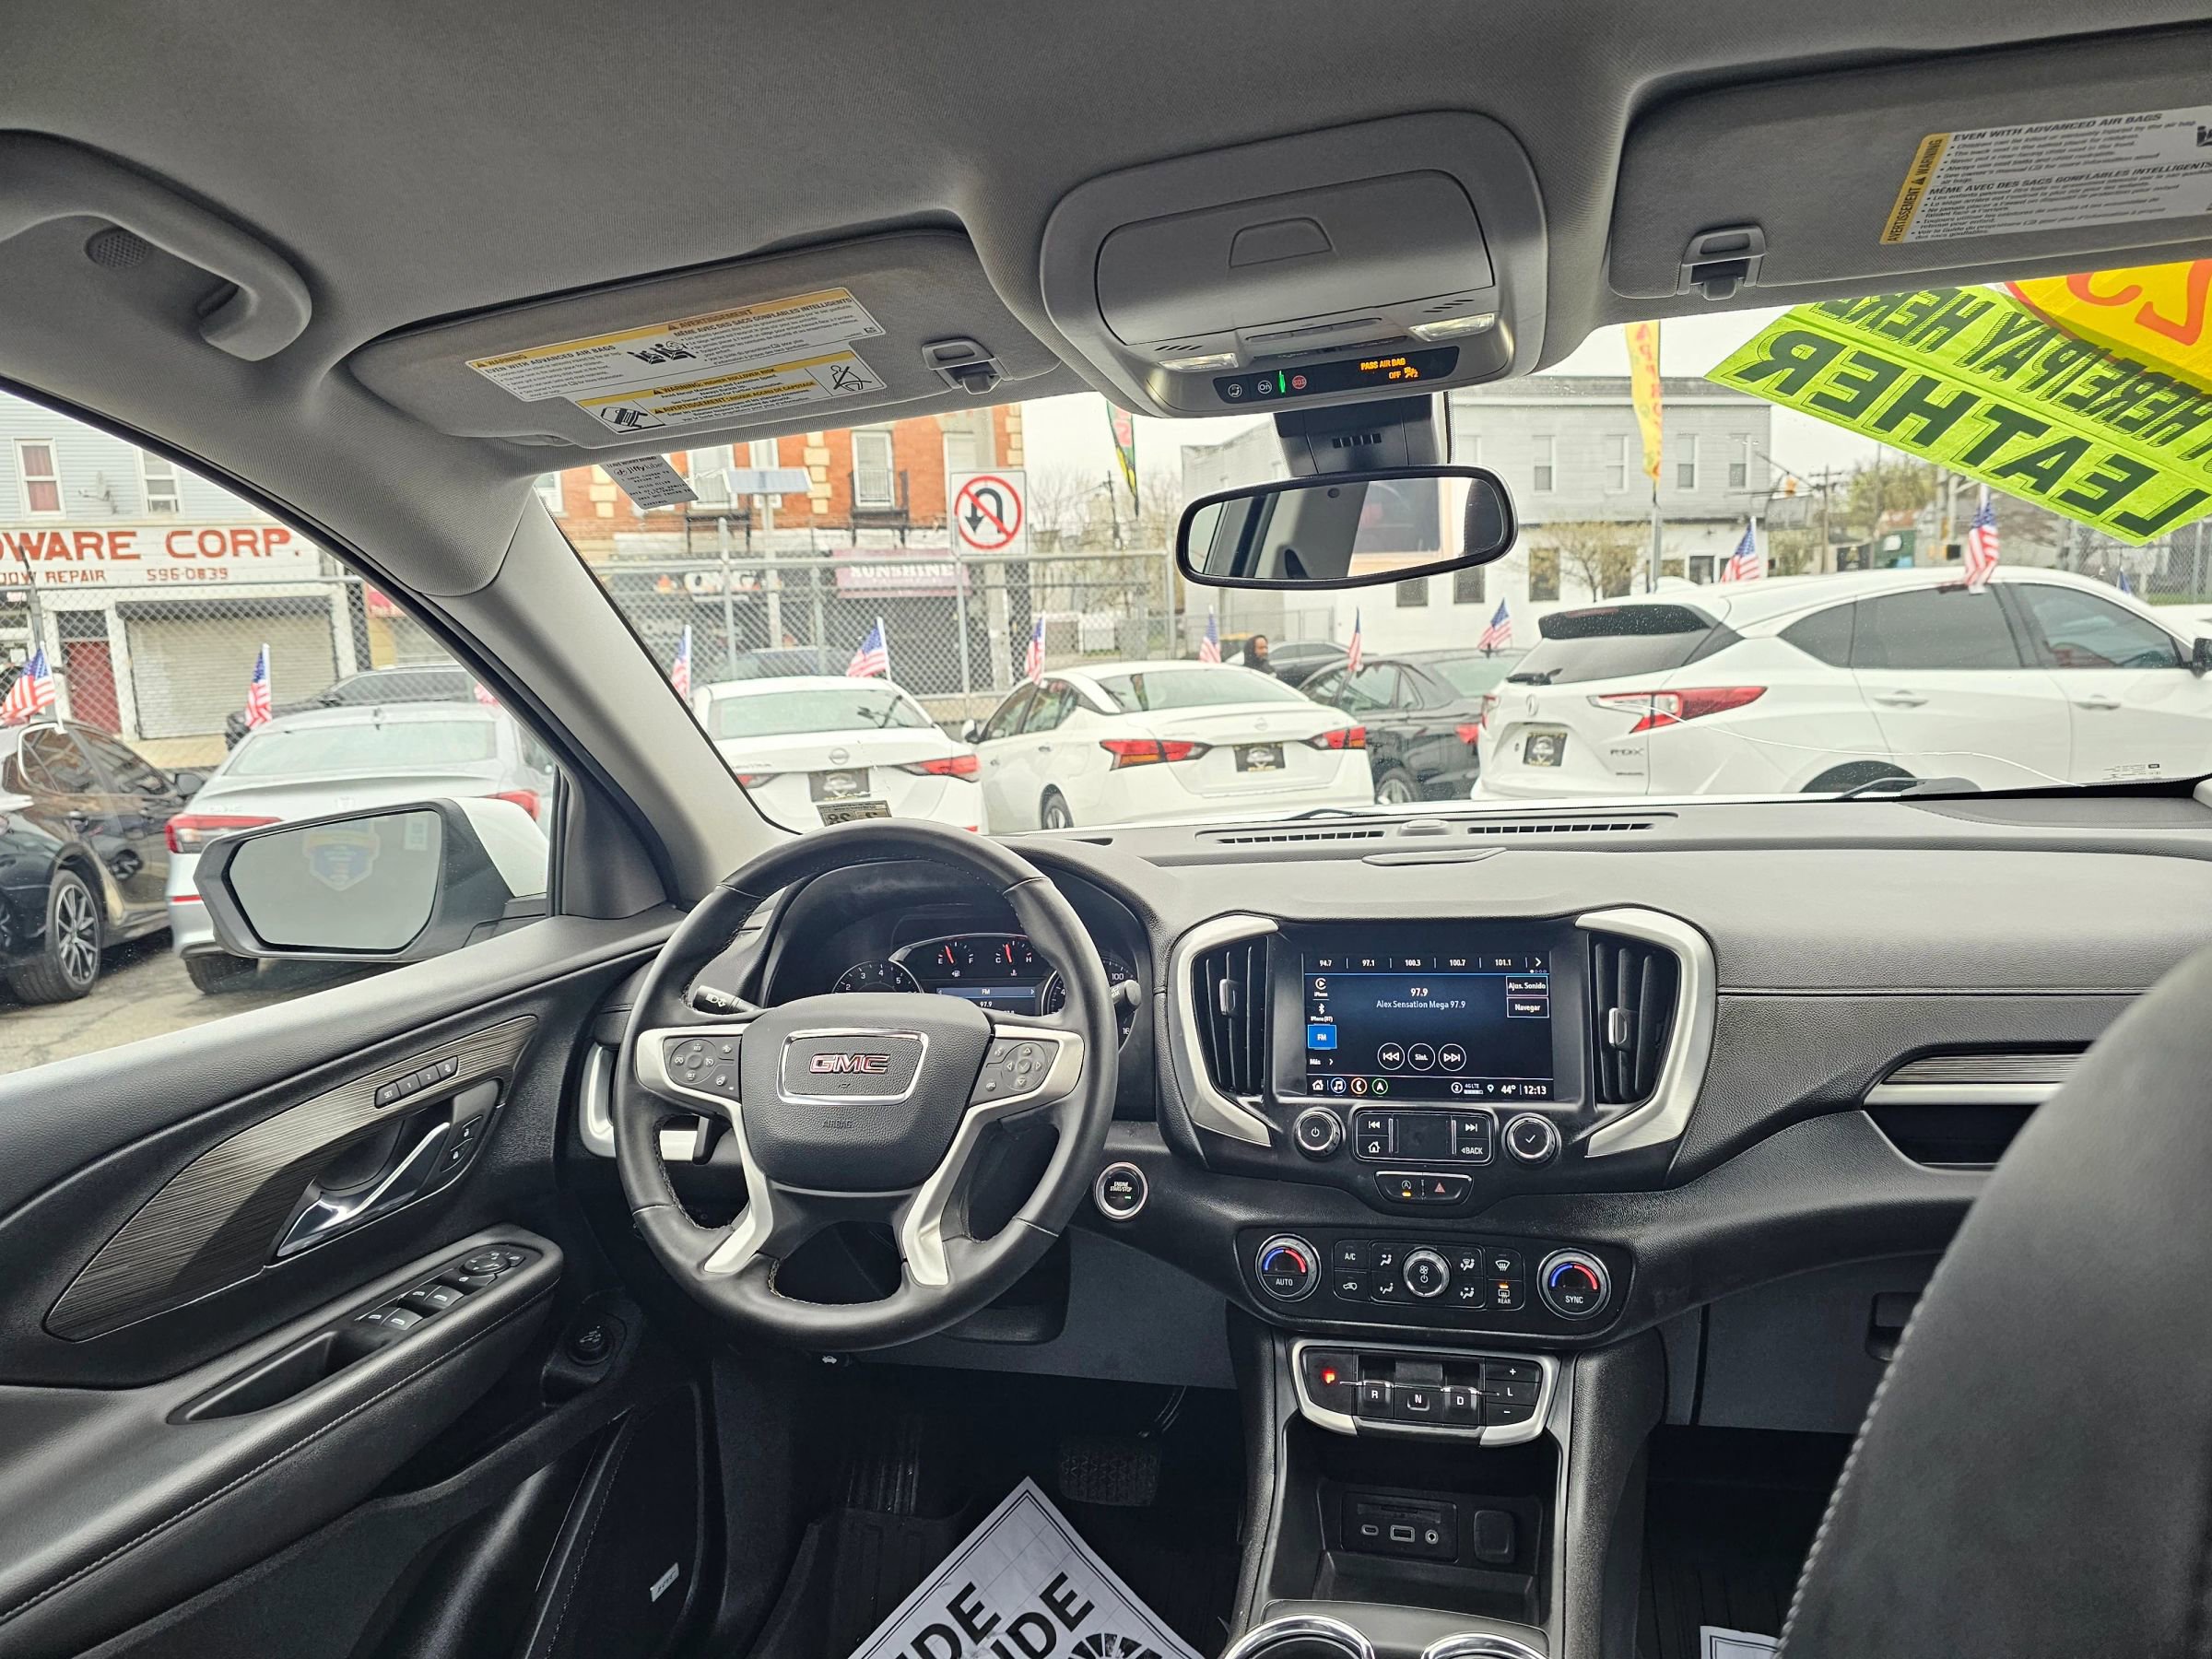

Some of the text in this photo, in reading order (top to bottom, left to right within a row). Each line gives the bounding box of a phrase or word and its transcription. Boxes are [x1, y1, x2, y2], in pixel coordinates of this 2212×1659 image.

[1953, 132, 1986, 142] EVEN
[1989, 129, 2022, 138] WITH
[2025, 120, 2096, 135] ADVANCED
[2100, 117, 2123, 126] AIR
[2124, 112, 2163, 124] BAGS
[1915, 139, 1943, 175] WARNING
[1929, 184, 1962, 195] MÊME
[1965, 183, 1994, 193] AVEC
[1996, 181, 2022, 189] DES
[2024, 177, 2052, 187] SACS
[1888, 187, 1921, 241] AVERTISSEMENT
[678, 309, 754, 329] AVERTISSEMENT
[530, 353, 574, 368] ADVANCED
[575, 348, 591, 359] AIR
[1360, 357, 1406, 371] PASS AIR BAG
[1388, 371, 1401, 380] OFF
[1292, 378, 1307, 386] SOS
[663, 382, 703, 394] WARNING:
[0, 528, 301, 561] WARE CORP.
[45, 569, 106, 583] REPAIR
[147, 567, 229, 582] 596-0839
[995, 956, 1002, 964] C
[1026, 956, 1032, 964] H
[861, 971, 866, 980] 3
[878, 969, 884, 977] 4
[1112, 972, 1124, 981] 100
[896, 976, 901, 984] 5
[845, 982, 851, 991] 2
[1524, 982, 1547, 990] Sonido
[1410, 988, 1428, 997] 97.9
[1376, 1000, 1466, 1010] Alex Sensation Mega 97.9
[1514, 1004, 1541, 1013] Navegar
[1316, 1033, 1327, 1041] FM
[809, 1053, 890, 1075] GMC
[1524, 1085, 1547, 1095] 12:13
[822, 1119, 853, 1129] AIRBAG
[1465, 1146, 1483, 1156] BACK
[1345, 1252, 1356, 1261] A/C
[1276, 1277, 1293, 1287] AUTO
[1565, 1295, 1584, 1305] SYNC
[1326, 1373, 1335, 1383] P
[1371, 1390, 1379, 1399] R
[1507, 1387, 1513, 1396] L
[1415, 1394, 1422, 1404] N
[1456, 1396, 1465, 1406] D
